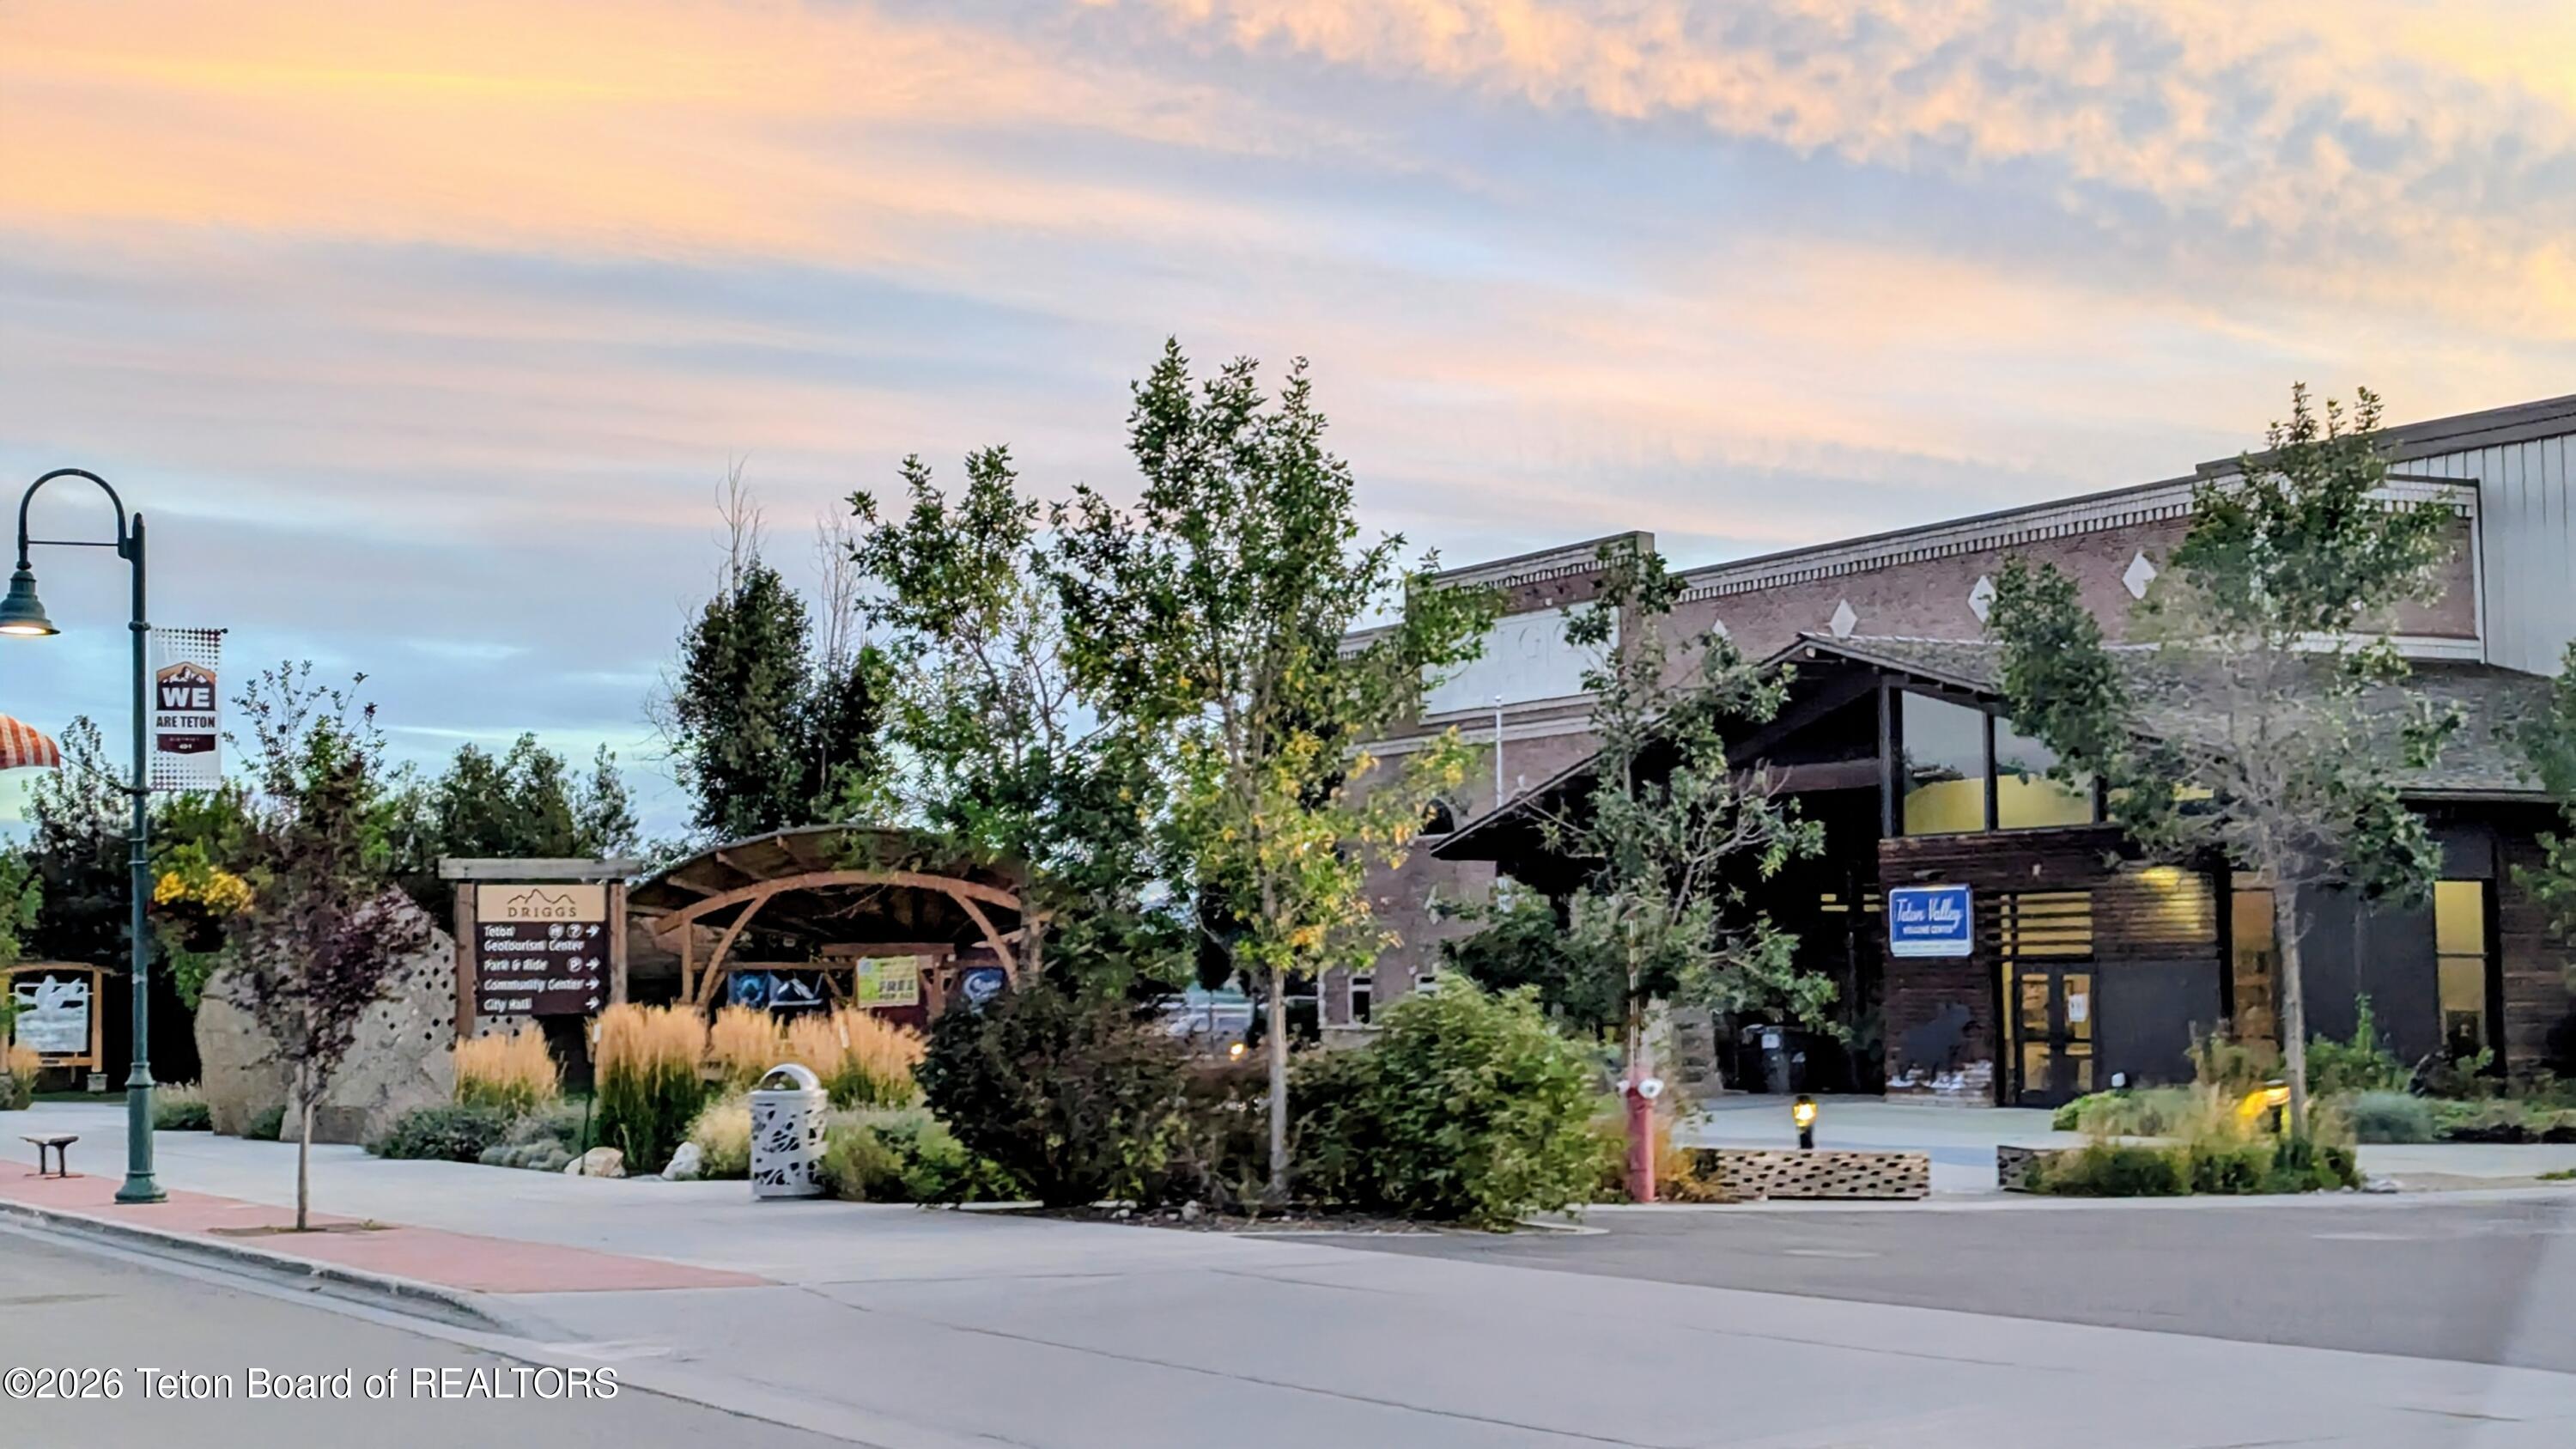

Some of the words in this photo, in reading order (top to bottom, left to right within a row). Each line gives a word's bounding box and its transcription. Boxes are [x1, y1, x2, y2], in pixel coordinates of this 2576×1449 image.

[162, 687, 210, 707] WE
[156, 716, 178, 728] ARE
[180, 716, 216, 728] TETON
[507, 907, 577, 917] DRIGGS
[1895, 899, 1926, 922] Teton
[1928, 897, 1964, 929] Valley
[484, 926, 516, 936] Teton
[484, 940, 548, 951] Geotourism
[550, 940, 586, 951] Center
[484, 959, 510, 971] Park
[523, 959, 549, 971] Ride
[484, 979, 546, 993] Community
[549, 978, 586, 989] Center
[484, 999, 507, 1013] City
[508, 998, 532, 1009] Hall
